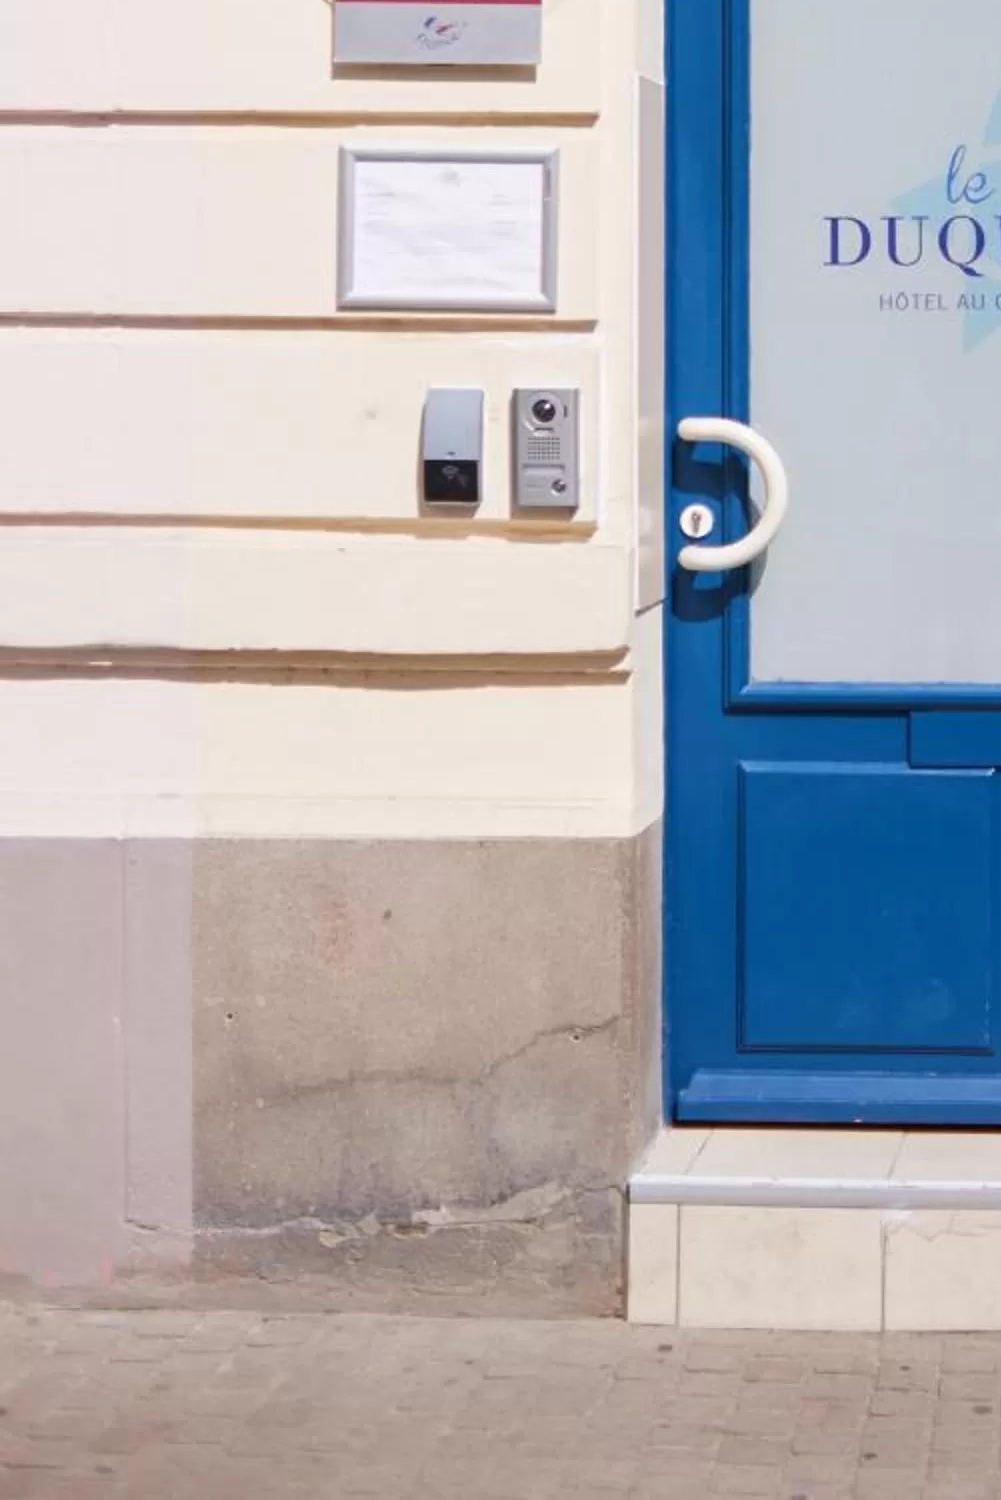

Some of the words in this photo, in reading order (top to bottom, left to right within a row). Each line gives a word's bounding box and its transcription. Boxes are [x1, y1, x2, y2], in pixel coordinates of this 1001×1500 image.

[945, 143, 996, 205] le
[879, 291, 949, 311] HÔTEL
[956, 293, 985, 311] AU
